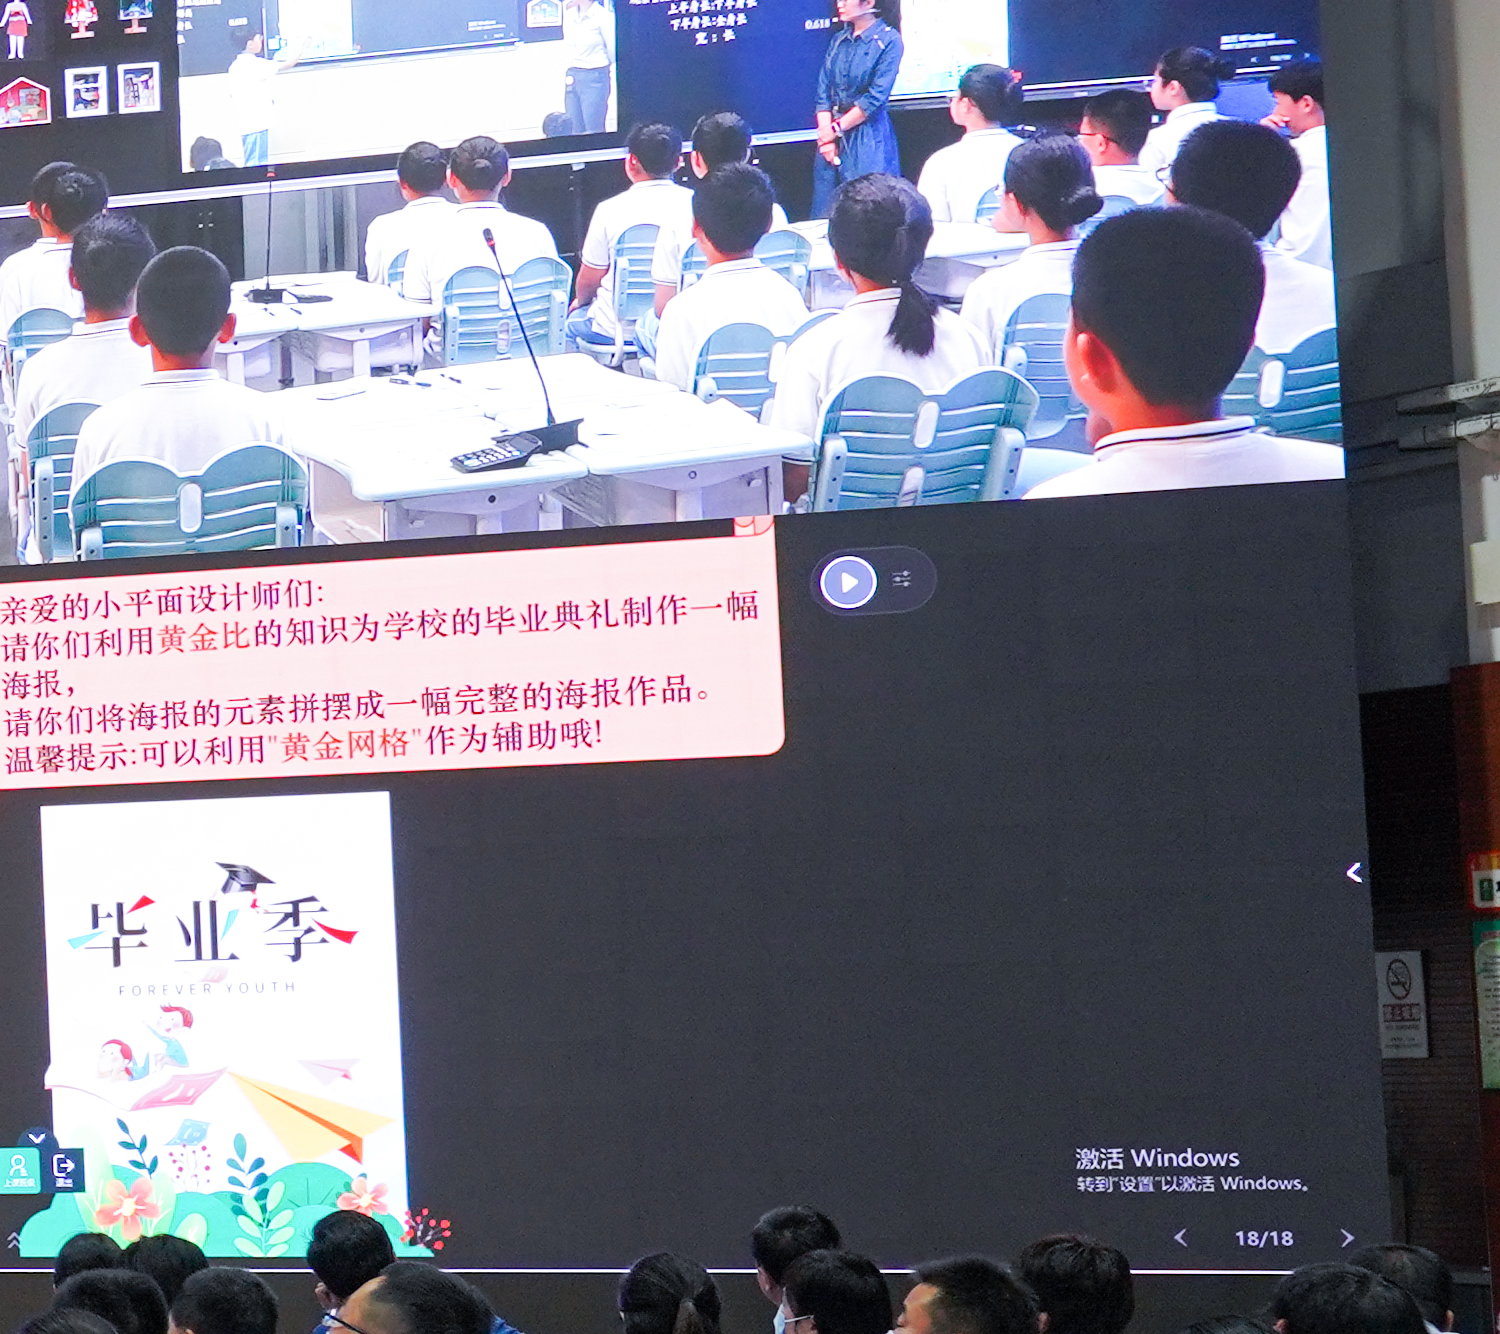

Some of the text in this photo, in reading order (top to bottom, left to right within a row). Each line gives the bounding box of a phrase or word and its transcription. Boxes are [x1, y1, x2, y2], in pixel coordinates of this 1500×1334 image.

[0, 579, 325, 626] 亲爱的小平面设计师们:
[0, 587, 760, 664] 请你们利用黄金比的知识为学校的毕业典礼制作一幅
[3, 673, 709, 739] 请你们将海报的元素拼摆成一幅完整的海报作品。
[66, 894, 359, 967] 毕业季
[118, 980, 297, 997] FOREVER YOUTH
[1075, 1146, 1240, 1171] 激活 Windows
[1235, 1229, 1295, 1248] 18/18
